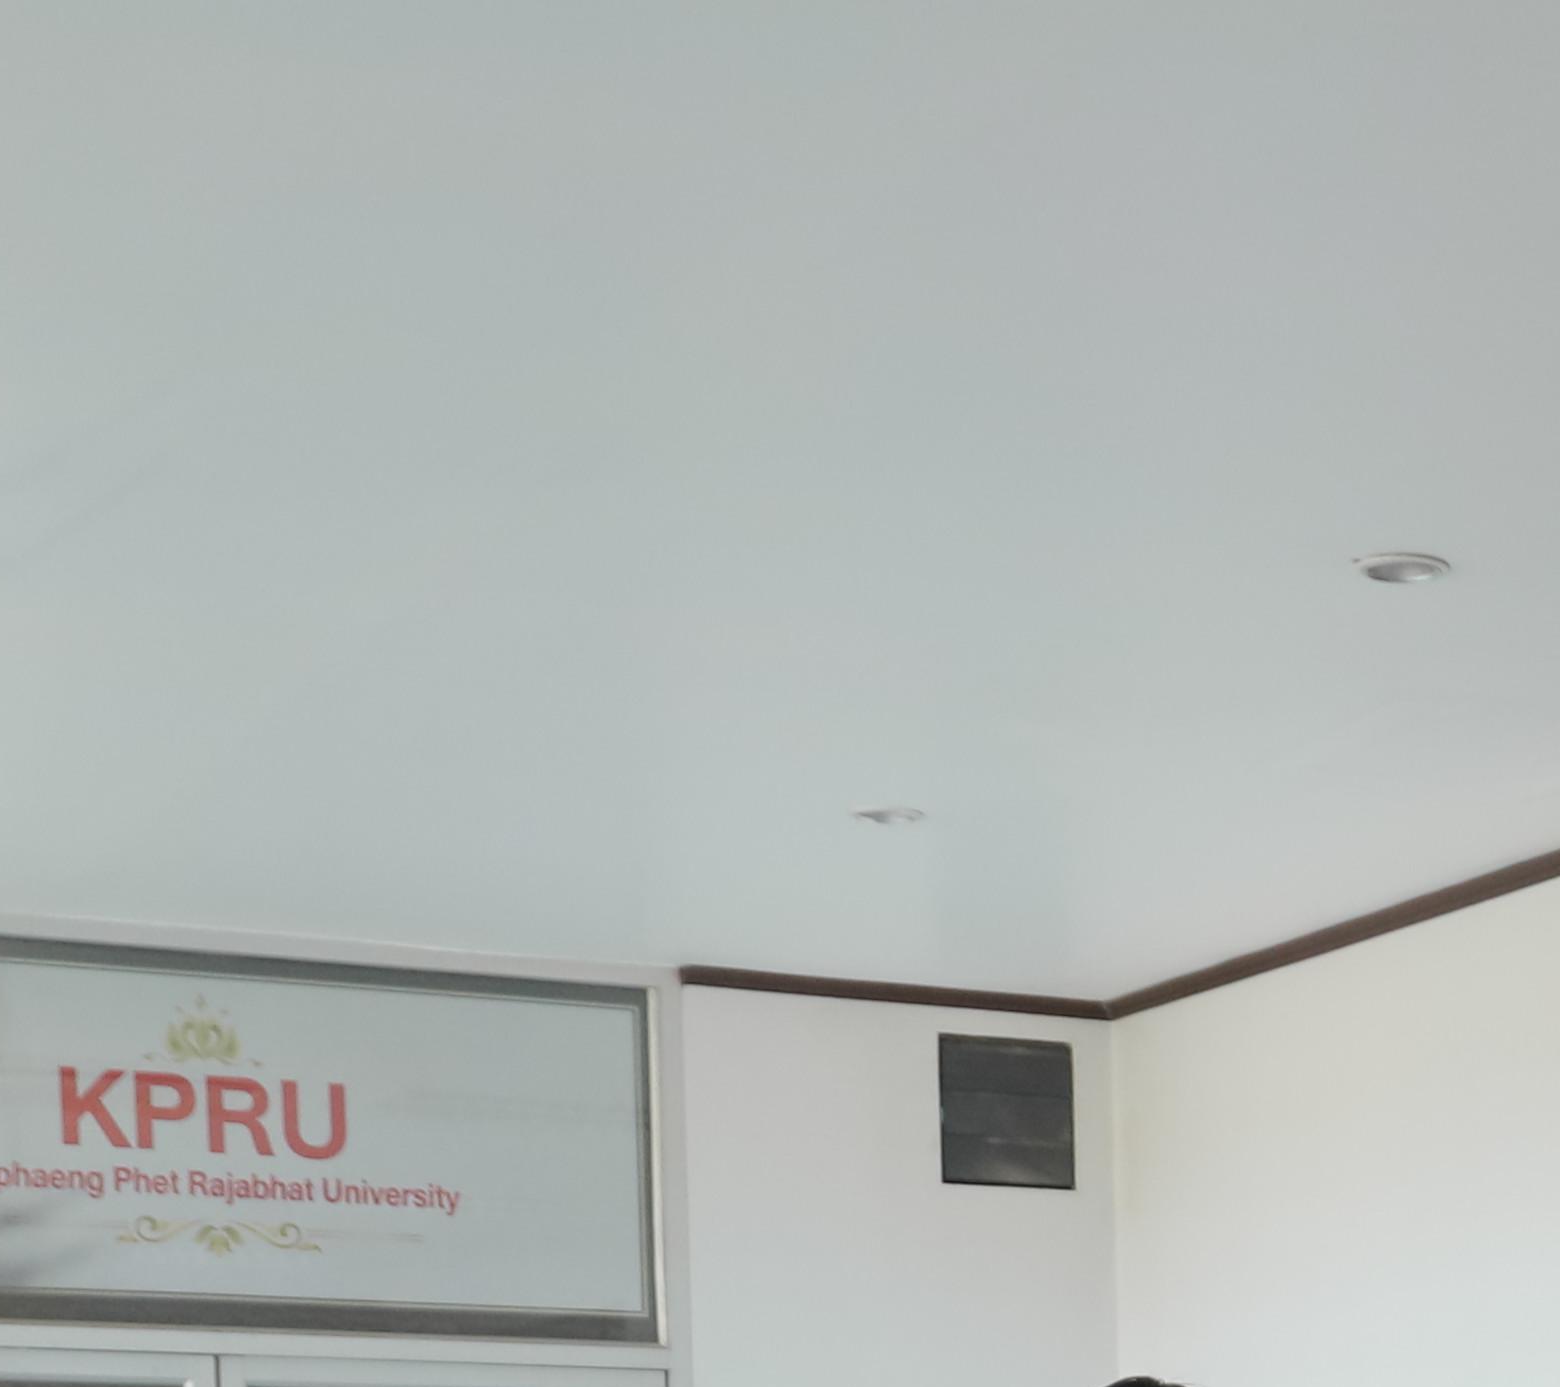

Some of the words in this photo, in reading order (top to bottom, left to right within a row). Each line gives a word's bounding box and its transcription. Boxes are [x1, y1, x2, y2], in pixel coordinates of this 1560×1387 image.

[58, 1065, 347, 1160] KPRU
[113, 1165, 181, 1195] Phet
[189, 1170, 313, 1204] Rajabhat
[322, 1177, 459, 1216] University
